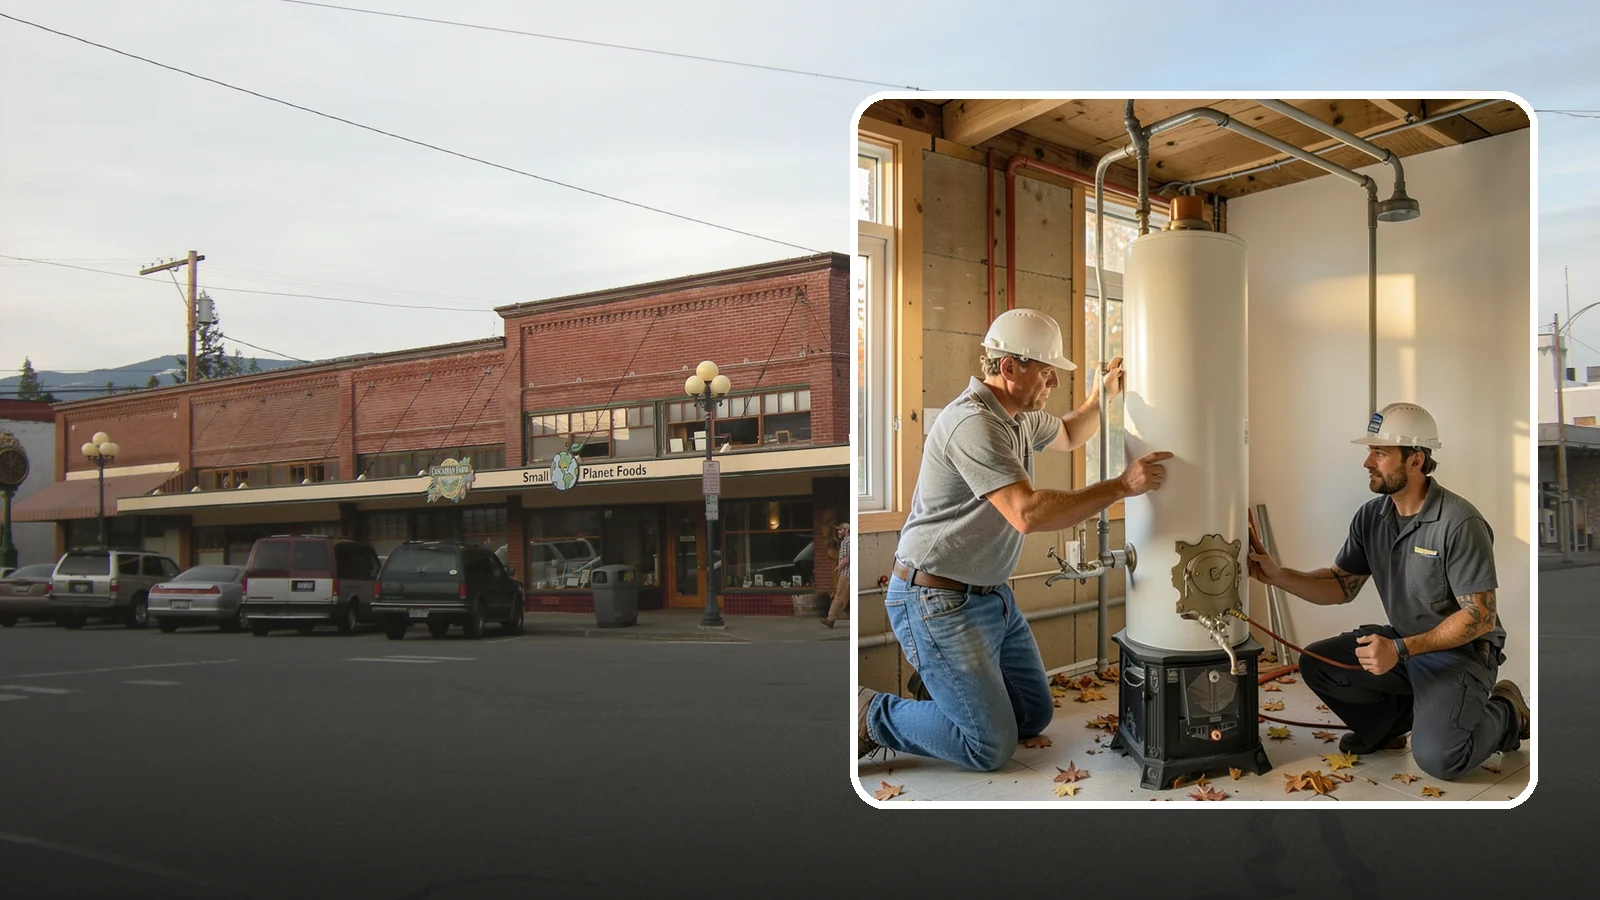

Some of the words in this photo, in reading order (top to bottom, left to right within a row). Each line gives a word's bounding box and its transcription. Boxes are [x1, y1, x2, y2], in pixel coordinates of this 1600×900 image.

[523, 471, 549, 483] Small
[583, 468, 614, 479] Planet
[617, 464, 647, 477] Foods
